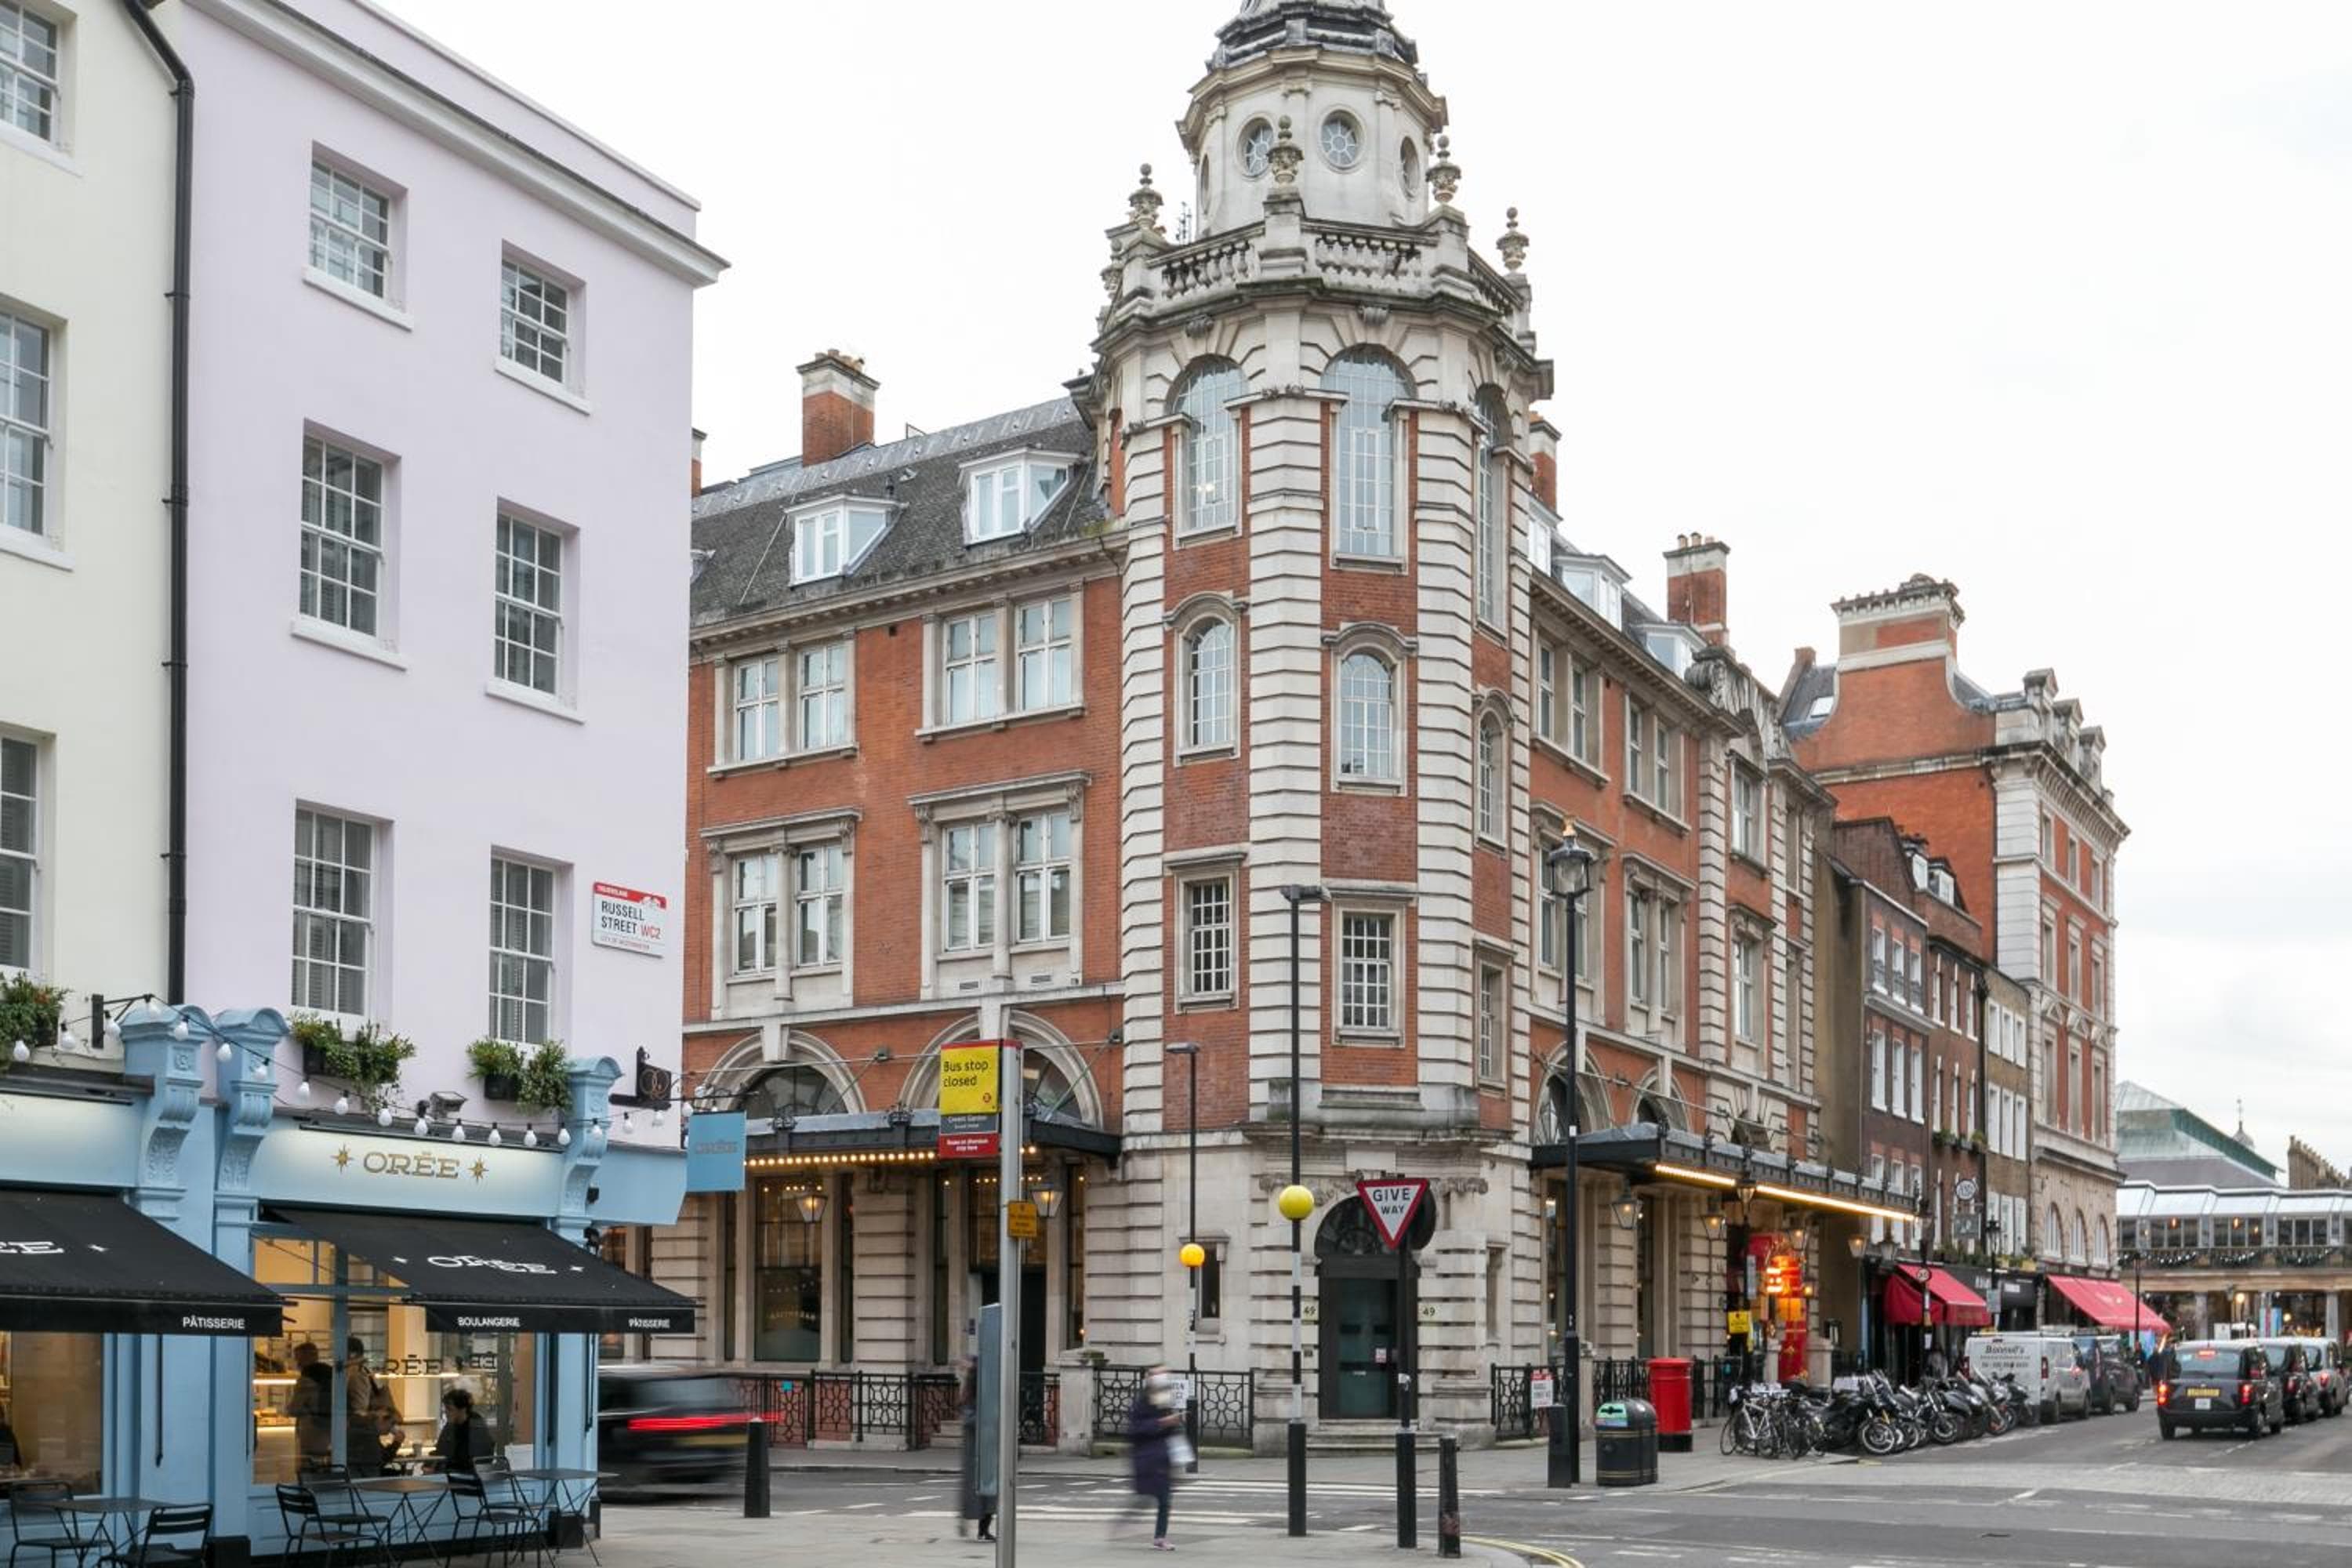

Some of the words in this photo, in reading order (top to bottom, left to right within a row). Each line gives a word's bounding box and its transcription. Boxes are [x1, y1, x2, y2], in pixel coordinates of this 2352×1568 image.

[601, 901, 644, 920] RUSSELL
[601, 916, 637, 935] STREET
[641, 924, 661, 939] WC2
[943, 1061, 962, 1072] Bus
[965, 1059, 989, 1073] stop
[943, 1075, 978, 1087] closed
[1373, 1188, 1410, 1202] GIVE
[1381, 1204, 1404, 1214] WAY
[1423, 1306, 1436, 1316] 49
[183, 1315, 245, 1330] PÂTISSERIE
[458, 1316, 521, 1327] BOULANGERIE
